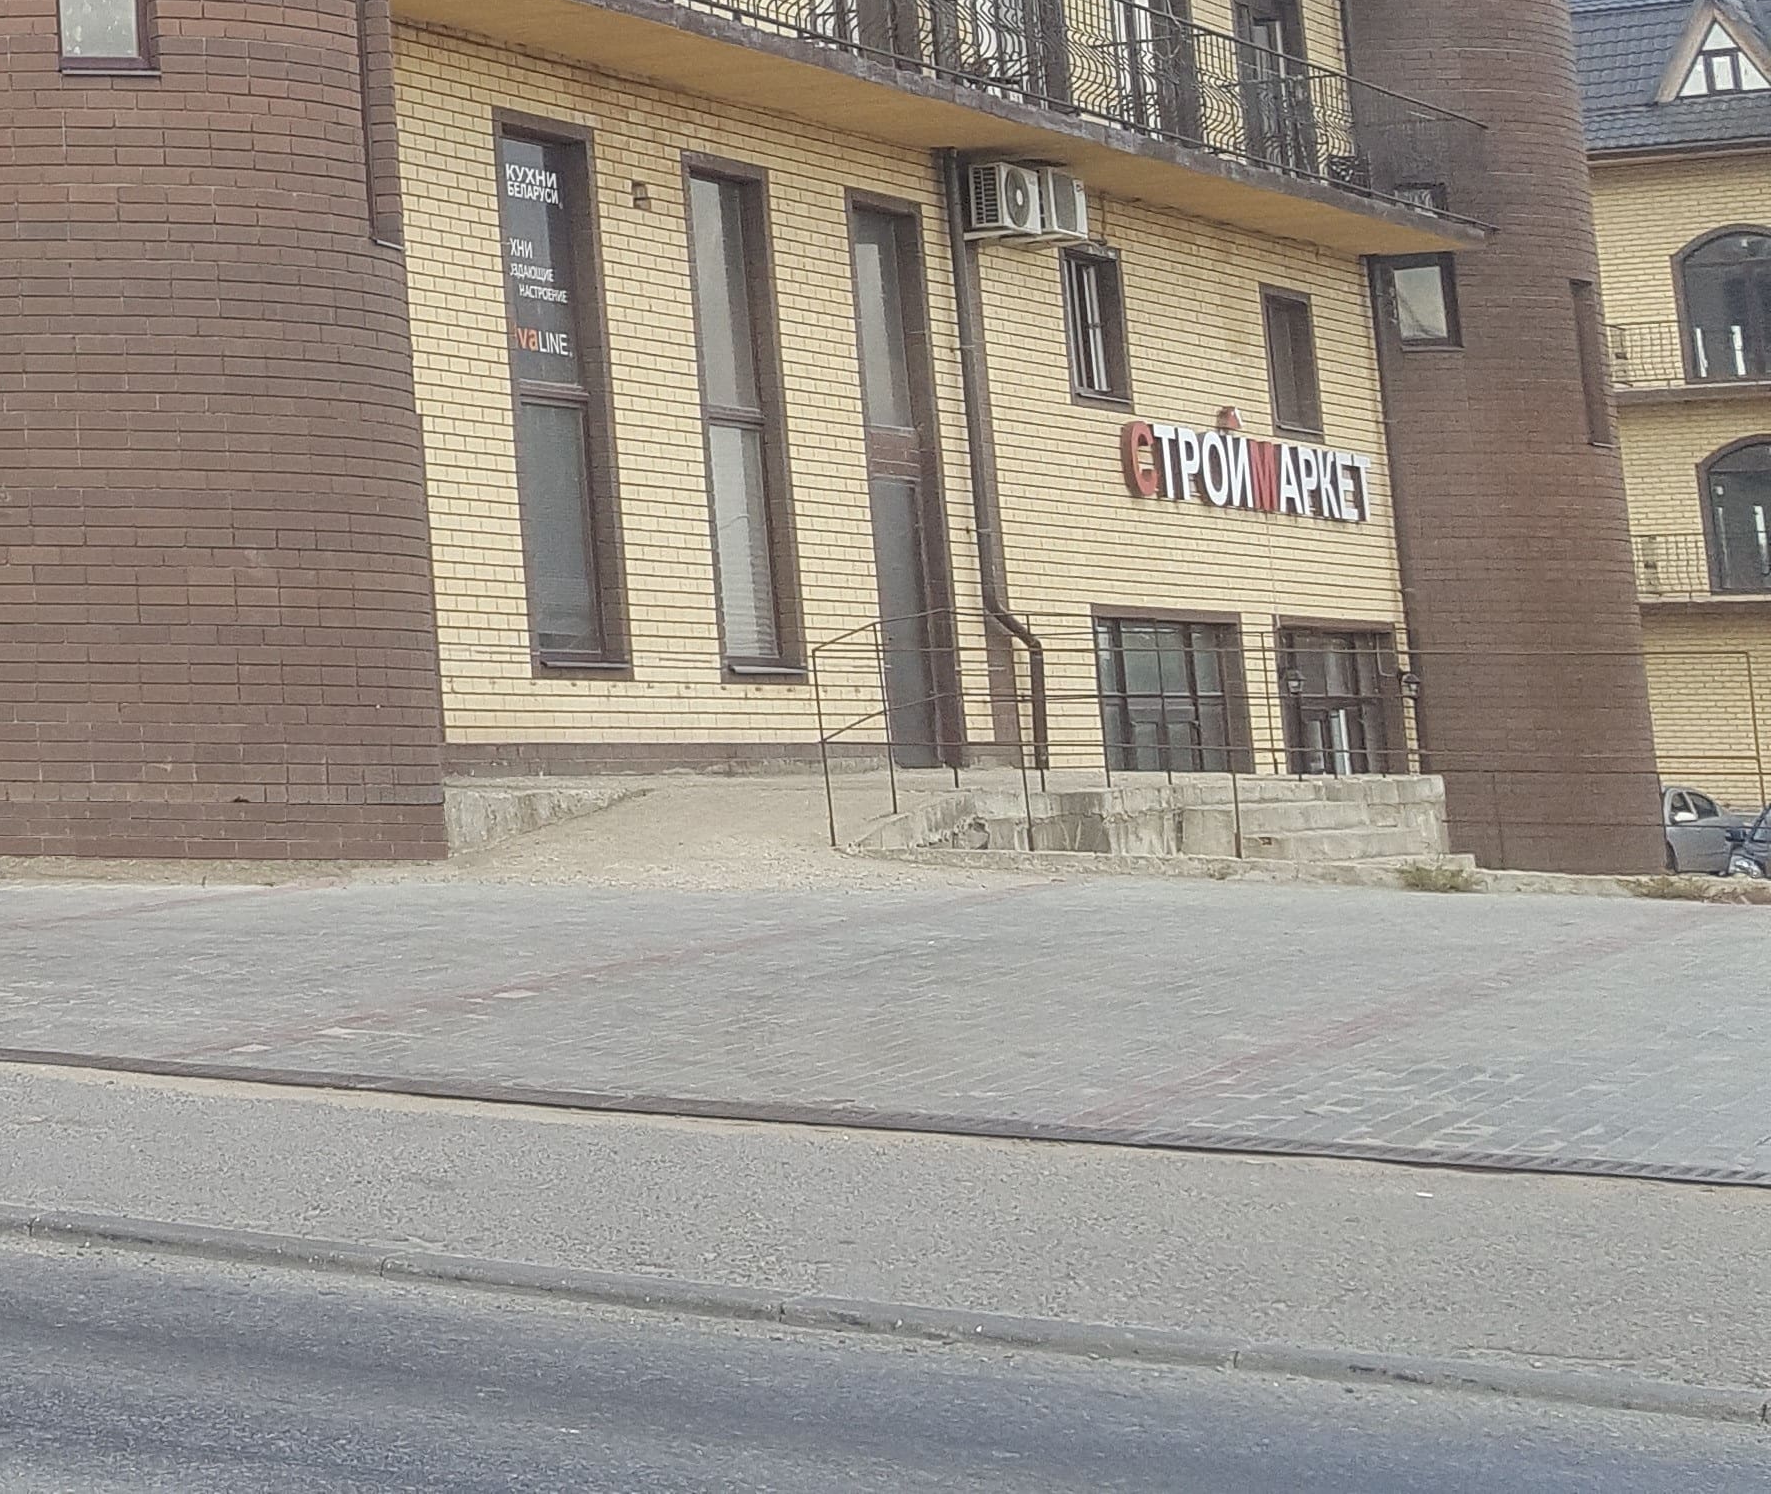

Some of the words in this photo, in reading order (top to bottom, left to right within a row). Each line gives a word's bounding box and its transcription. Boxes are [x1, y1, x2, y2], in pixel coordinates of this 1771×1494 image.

[505, 163, 557, 189] КУХНИ
[510, 237, 534, 259] ХНИ
[1121, 414, 1371, 522] СТРОЙМАРКЕТ
